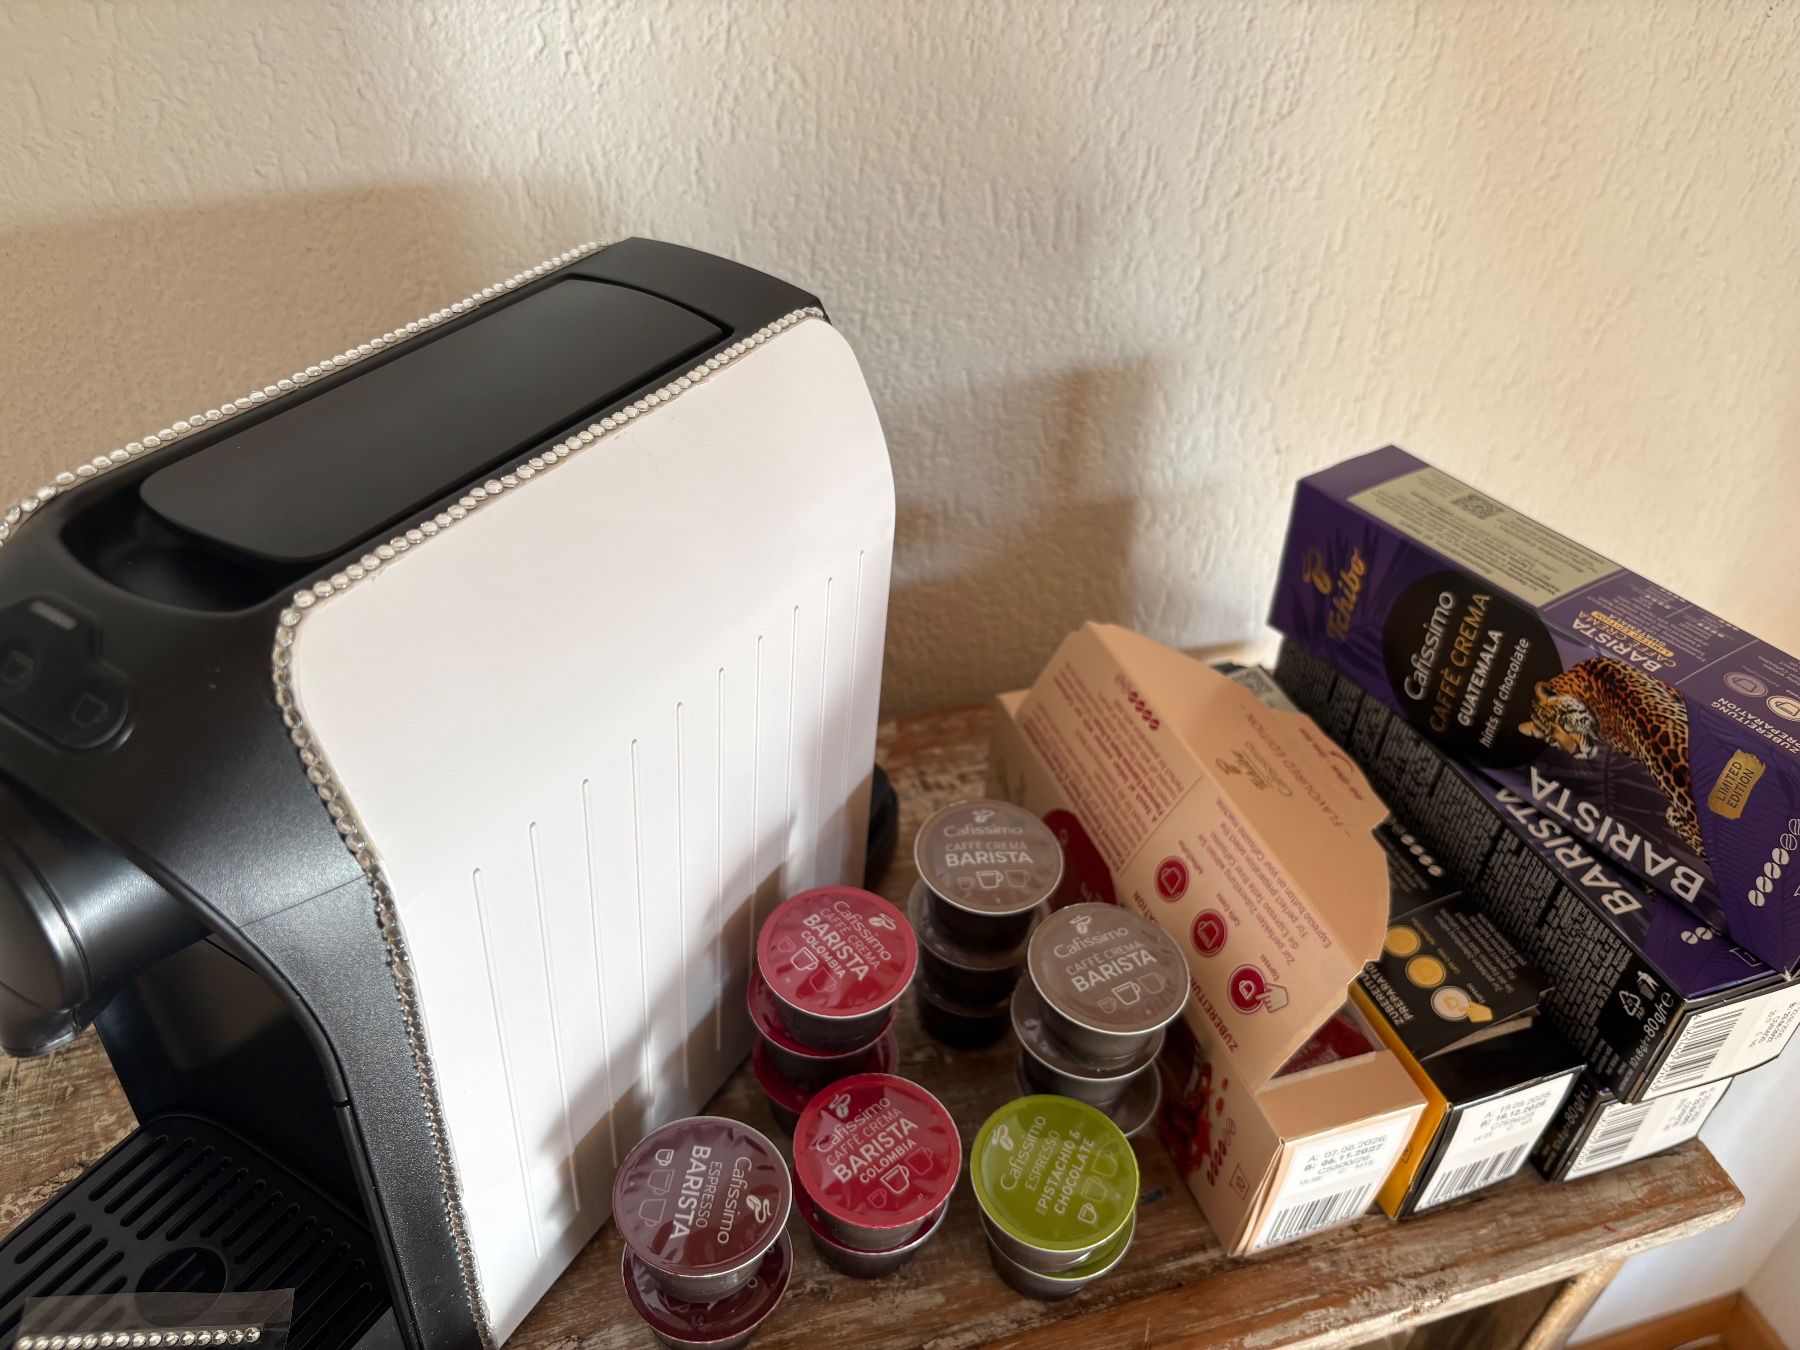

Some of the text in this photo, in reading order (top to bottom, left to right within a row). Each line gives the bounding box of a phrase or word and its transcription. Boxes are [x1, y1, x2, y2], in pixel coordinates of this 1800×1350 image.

[1404, 591, 1455, 700] Cafissimo
[1451, 593, 1490, 667] CREMA
[1571, 617, 1662, 673] BARISTA
[1578, 609, 1627, 640] CREMA
[1457, 629, 1503, 727] GUATEMALA
[1479, 637, 1529, 749] hints of chocolate
[1711, 701, 1799, 754] ZUBEREITUNG
[1717, 697, 1800, 750] PREPARATION
[1715, 761, 1742, 801] LIMITED
[1727, 768, 1754, 809] EDITION
[943, 824, 1023, 837] Cafissimo
[985, 839, 1028, 850] CREMA
[1495, 788, 1643, 916] BARISTA
[1530, 766, 1705, 903] BARISTA
[945, 850, 1034, 867] BARISTA
[801, 930, 846, 978] COLOMBIA
[802, 914, 869, 981] BARISTA
[834, 901, 891, 961] Cafissimo
[847, 935, 880, 969] CREMA
[1054, 927, 1129, 958] Cafissimo
[1103, 940, 1144, 960] CREMA
[1300, 911, 1333, 949] Espresso
[1071, 949, 1157, 992] BARISTA
[1364, 961, 1414, 1019] PREPARATIO
[1359, 971, 1404, 1026] ZUBEREITU
[816, 1097, 891, 1152] Cafissimo
[862, 1107, 903, 1137] CREMA
[1069, 1129, 1080, 1139] &
[833, 1117, 918, 1183] BARISTA
[860, 1139, 917, 1183] COLOMBIA
[1000, 1115, 1046, 1190] Cafissimo
[1025, 1130, 1060, 1191] ESPRESSO
[1054, 1137, 1095, 1215] CHOCOLATE
[669, 1145, 712, 1239] BARISTA
[696, 1161, 723, 1228] ESPRESSO
[717, 1156, 752, 1244] Cafissimo
